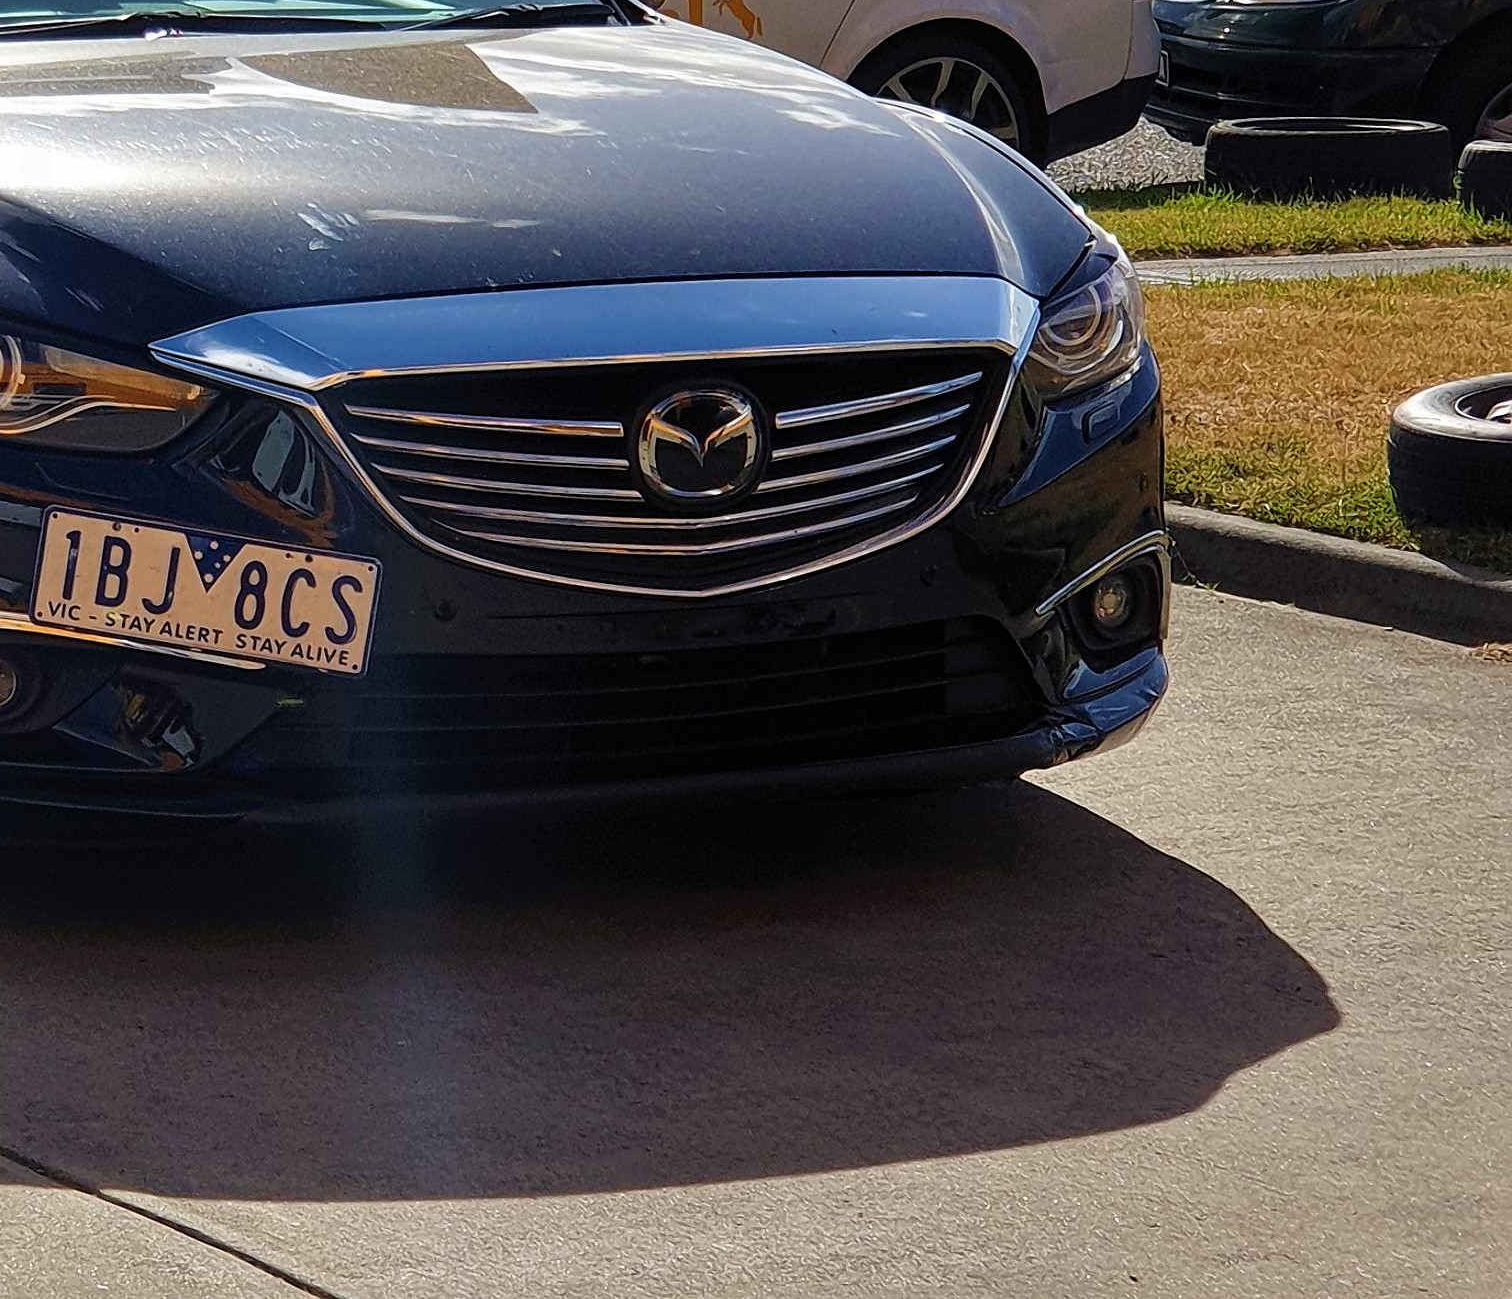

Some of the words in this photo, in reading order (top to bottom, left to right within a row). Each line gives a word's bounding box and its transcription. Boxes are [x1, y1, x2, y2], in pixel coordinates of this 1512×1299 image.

[61, 530, 181, 615] 1BJ
[234, 560, 363, 645] 8CS
[48, 600, 82, 621] VIC
[105, 611, 155, 634] STAY
[163, 620, 224, 645] ALERT
[235, 633, 287, 655] STAY
[291, 642, 349, 666] ALIVE
